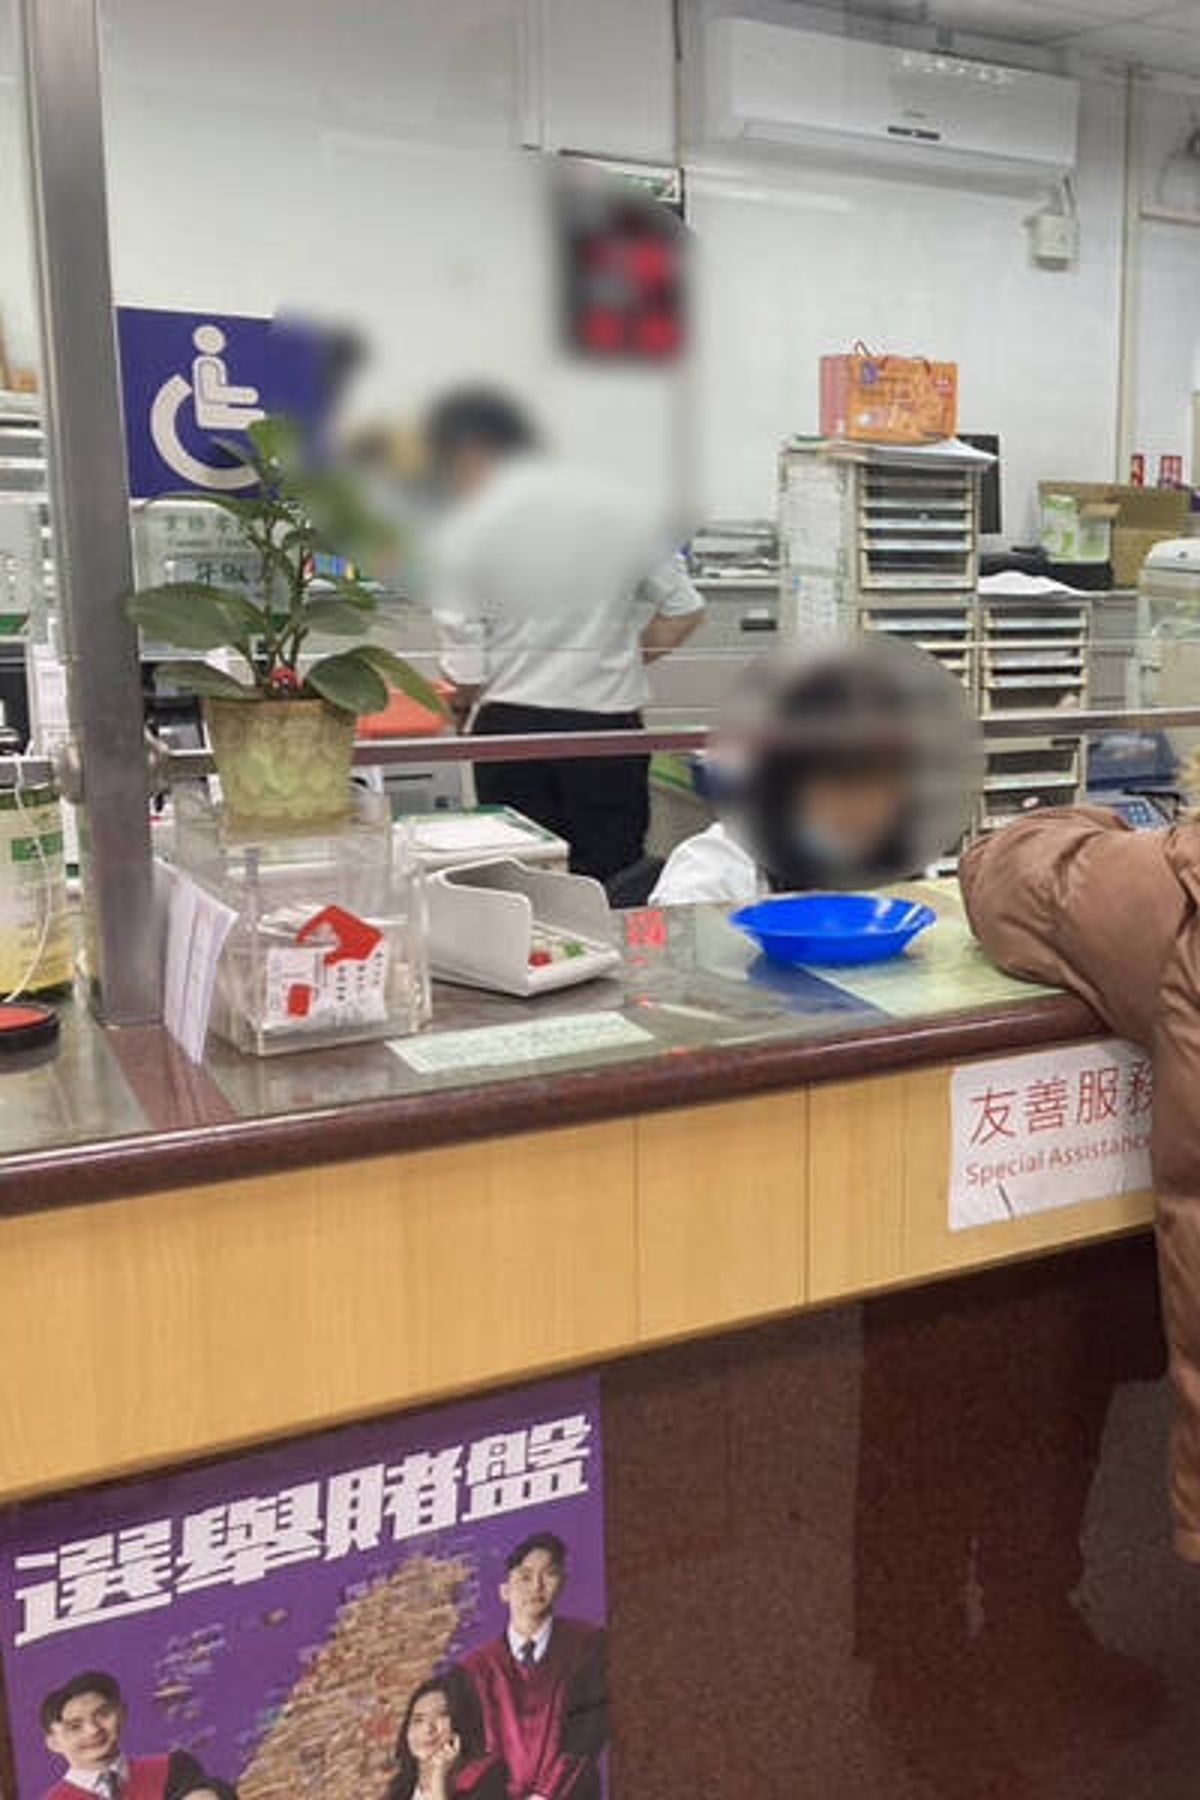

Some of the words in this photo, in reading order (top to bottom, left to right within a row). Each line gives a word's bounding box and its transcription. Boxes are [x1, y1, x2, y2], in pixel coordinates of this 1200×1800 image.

[966, 1152, 1045, 1187] Special
[14, 1413, 593, 1648] 選舉賭盤
